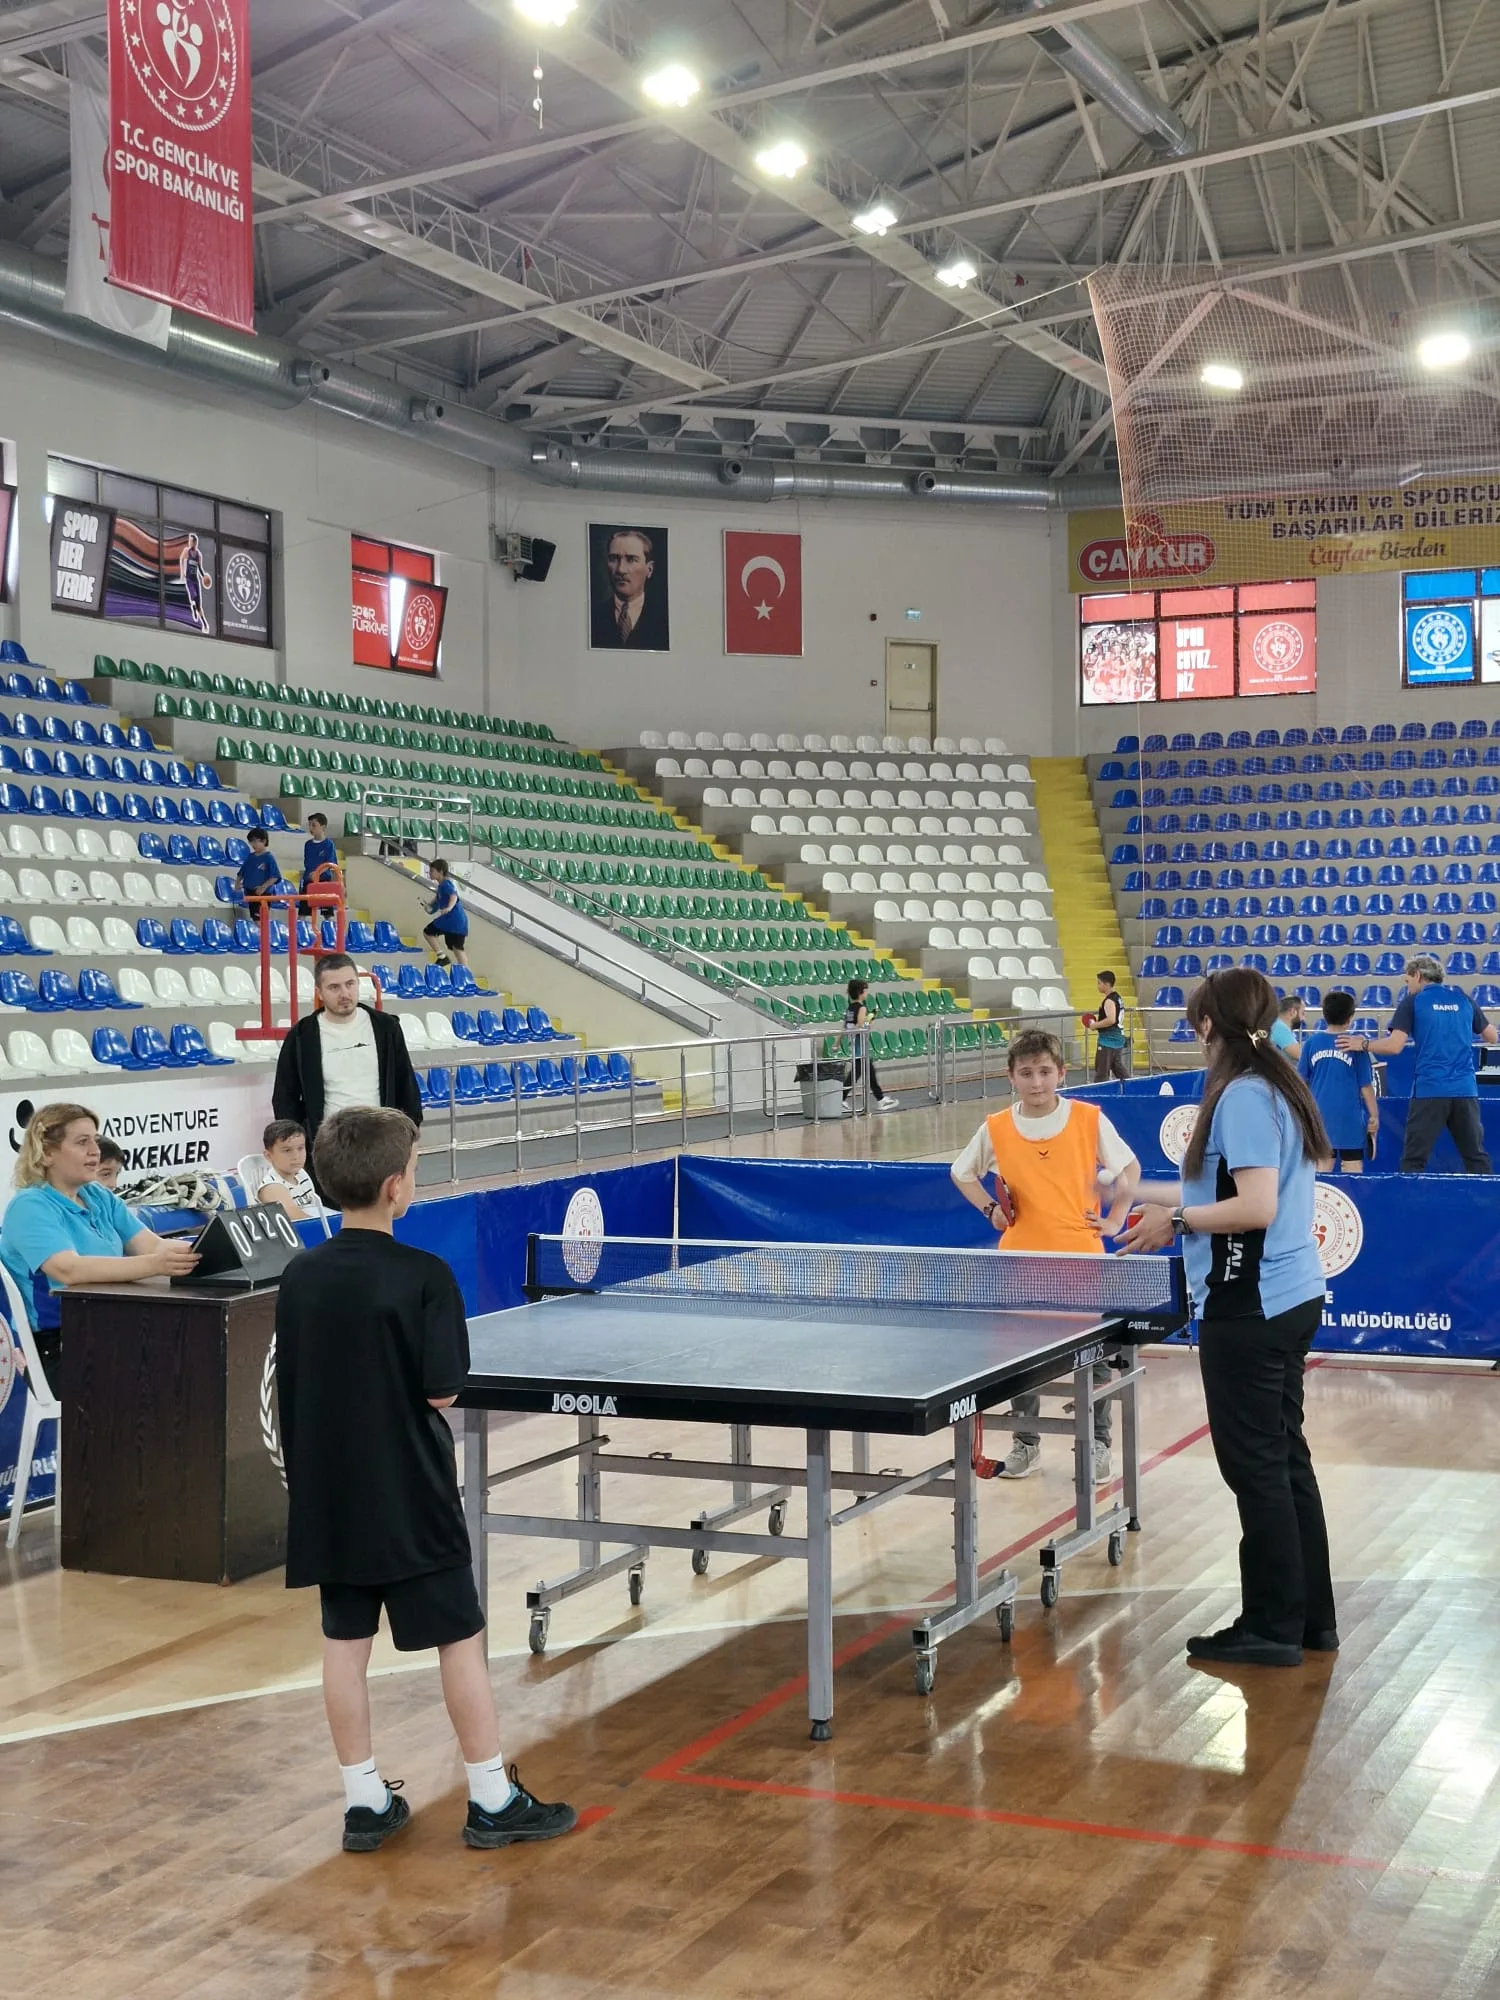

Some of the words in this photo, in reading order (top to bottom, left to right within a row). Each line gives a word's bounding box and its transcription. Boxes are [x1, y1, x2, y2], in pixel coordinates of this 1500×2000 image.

[120, 120, 149, 152] T.C.
[153, 136, 221, 181] GENÇLİK
[221, 165, 240, 191] VE
[114, 150, 159, 186] SPOR
[162, 170, 245, 222] BAKANLIĞI
[1223, 499, 1275, 520] TÜM
[1284, 495, 1359, 517] TAKIM
[1367, 494, 1393, 510] ve
[1403, 484, 1500, 508] SPORCU
[62, 510, 99, 543] SPOR
[1271, 513, 1404, 541] BAŞARILAR
[1414, 502, 1500, 529] DİLERİZ
[58, 540, 85, 571] HER
[1087, 542, 1207, 578] ÇAYKUR
[1379, 537, 1448, 562] Bizden
[56, 570, 96, 603] YERDE
[102, 1108, 219, 1138] ARDVENTURE
[121, 1140, 210, 1171] RKEKLER
[1321, 1309, 1337, 1327] İL
[1341, 1310, 1452, 1331] MÜDÜRLÜĞÜ
[551, 1392, 618, 1416] JOOLA
[949, 1393, 977, 1424] JOOLA
